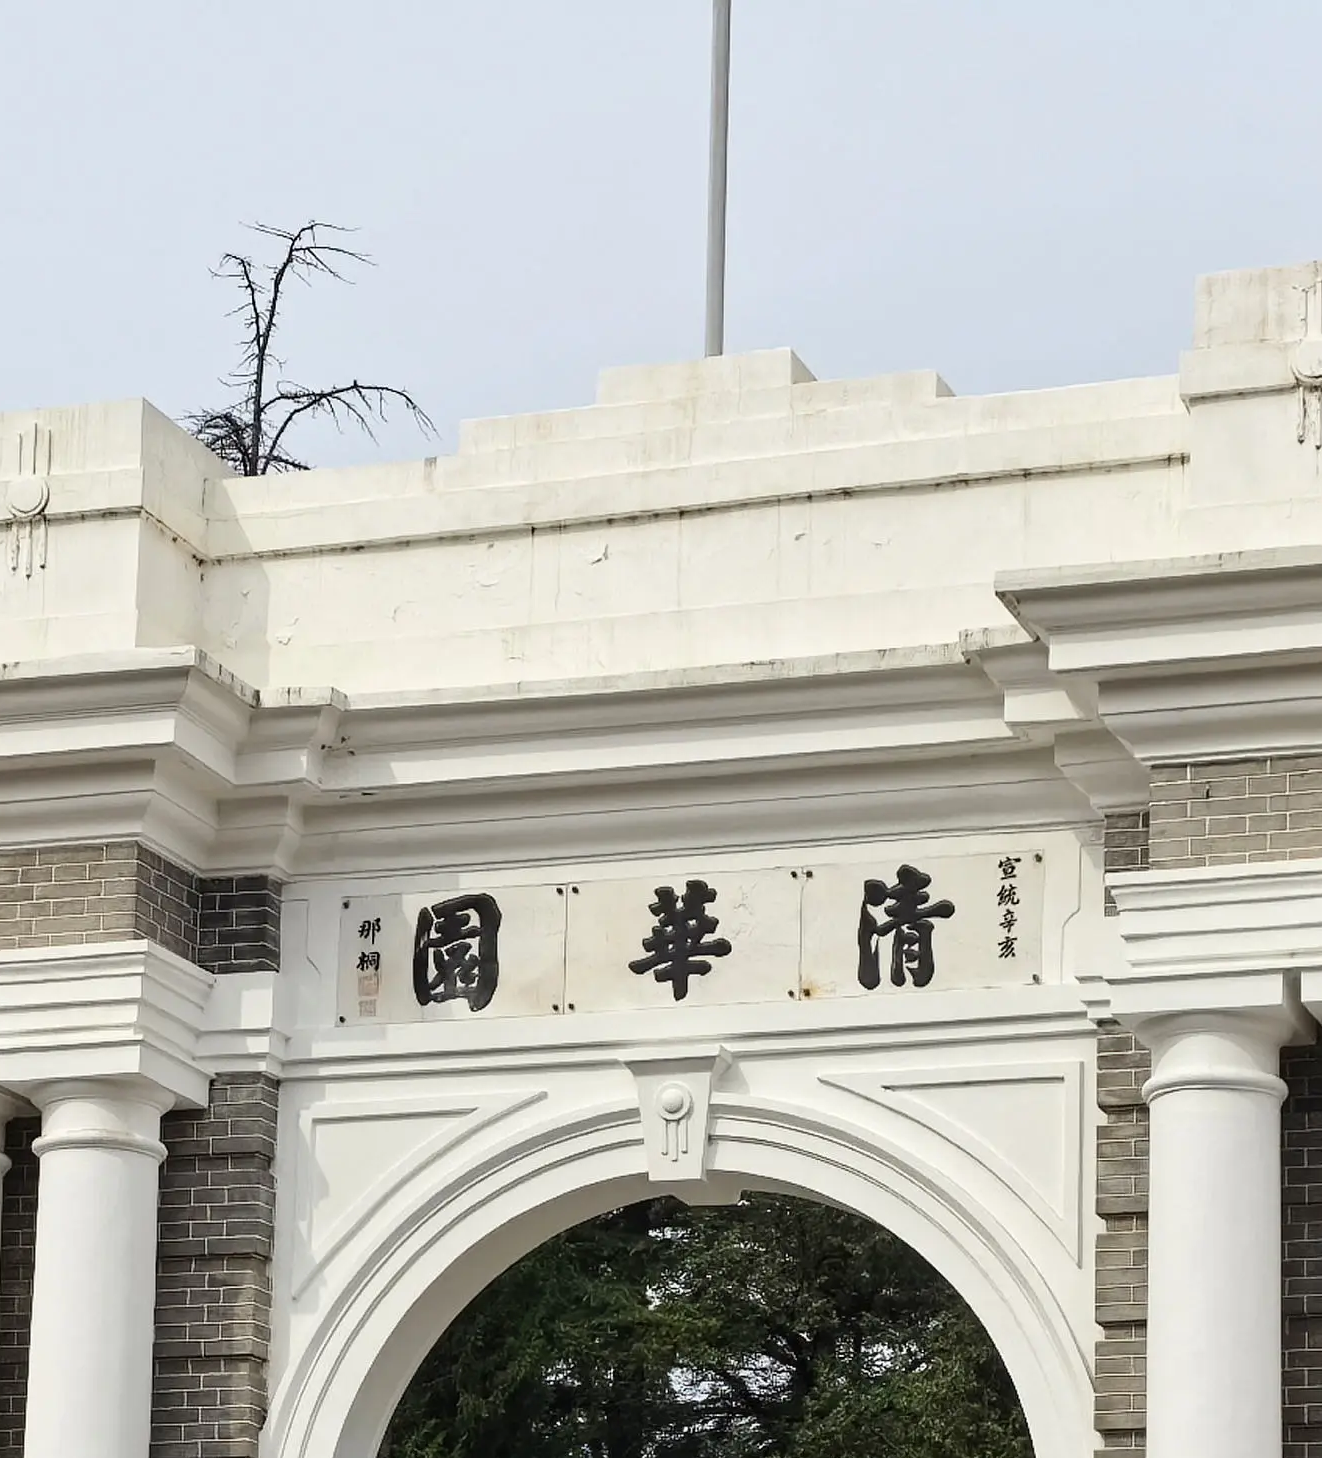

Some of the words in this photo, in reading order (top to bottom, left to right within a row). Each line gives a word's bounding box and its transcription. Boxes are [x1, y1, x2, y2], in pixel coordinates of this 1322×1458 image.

[356, 917, 381, 972] 那桐
[413, 864, 956, 1012] 清華園
[996, 856, 1022, 959] 宣統辛亥
